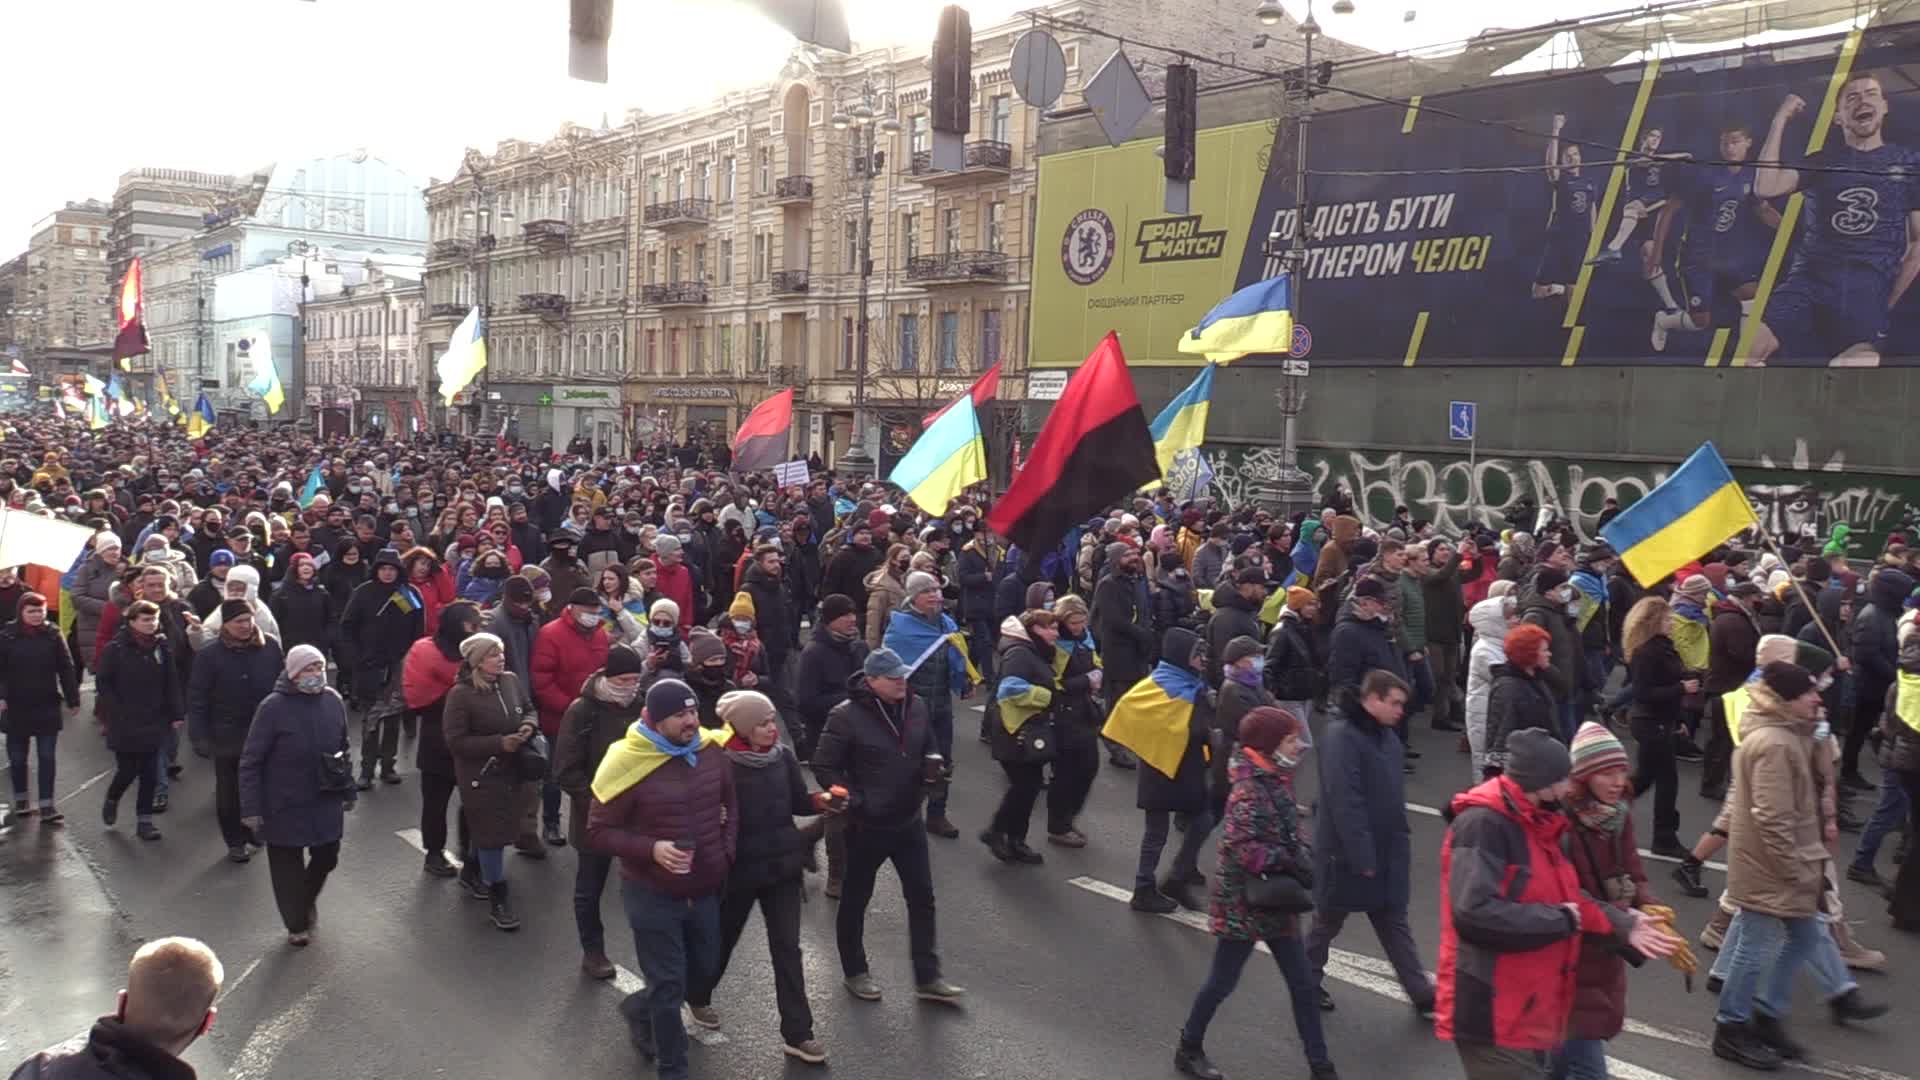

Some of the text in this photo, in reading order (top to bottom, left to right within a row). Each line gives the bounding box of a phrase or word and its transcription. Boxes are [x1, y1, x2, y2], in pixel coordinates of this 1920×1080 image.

[1151, 220, 1197, 241] PARI
[1271, 193, 1456, 241] ГОДІСТЬ БУТИ
[1159, 235, 1222, 258] MATCH
[1411, 235, 1493, 273] ЧЕЛСІ
